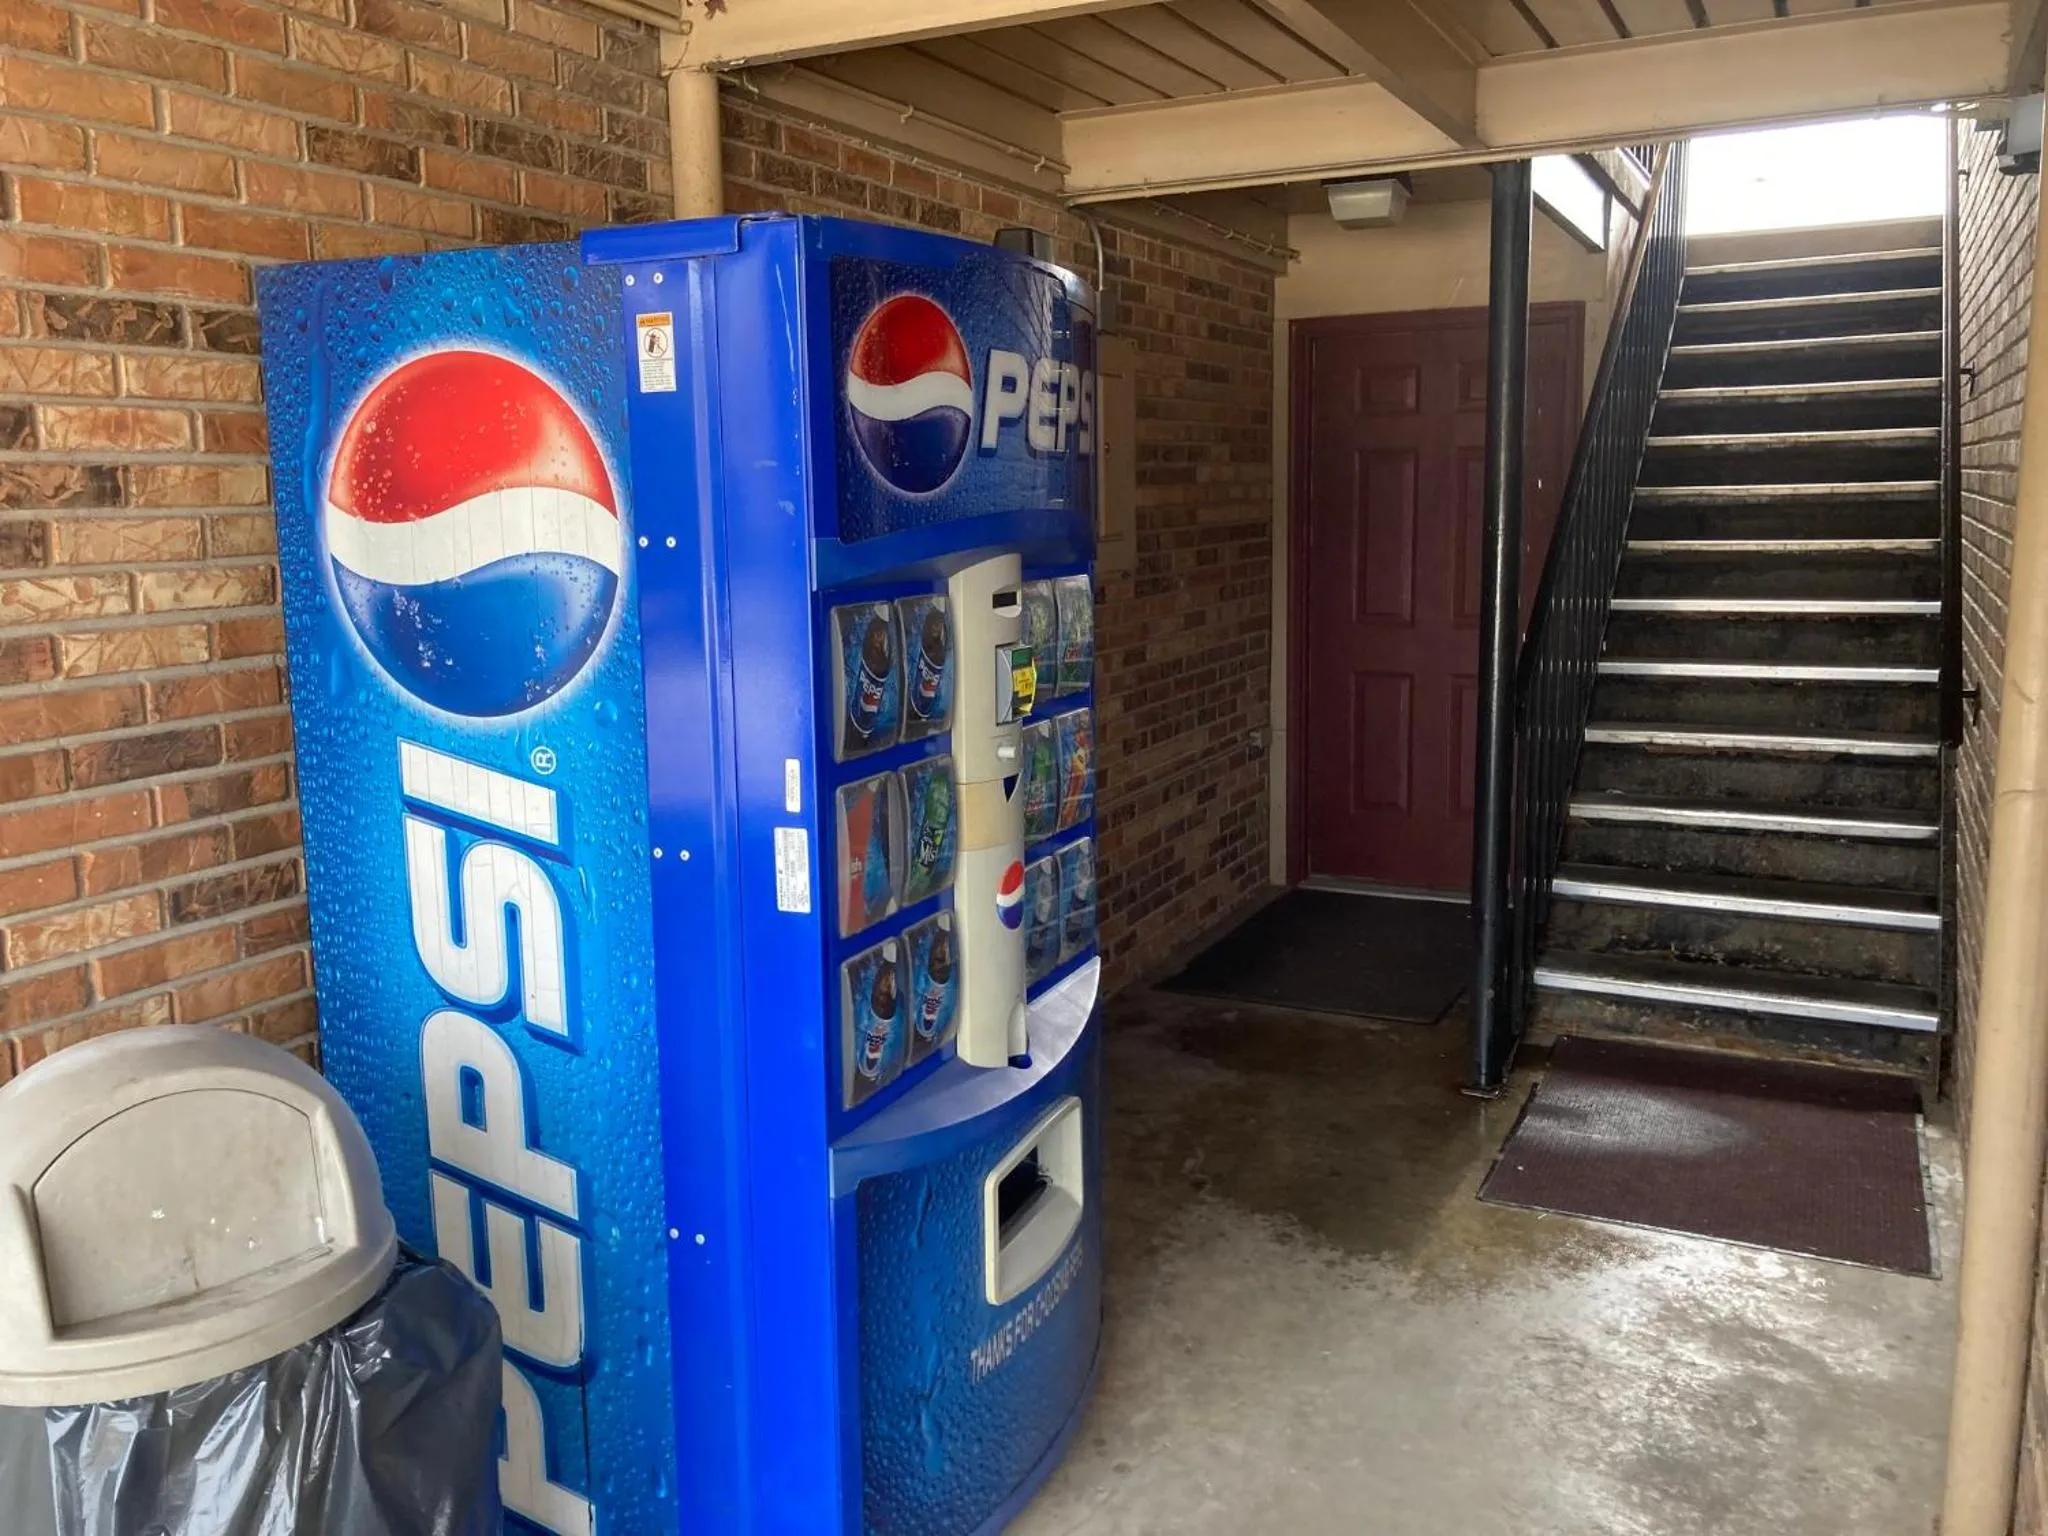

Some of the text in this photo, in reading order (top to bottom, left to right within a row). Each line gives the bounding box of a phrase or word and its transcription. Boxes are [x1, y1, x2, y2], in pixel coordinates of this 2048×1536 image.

[981, 349, 1095, 453] PEPS
[860, 670, 884, 700] PEPS
[397, 736, 596, 1536] PEPSI
[970, 1320, 1013, 1385] THANKS
[1014, 1300, 1035, 1348] FOR
